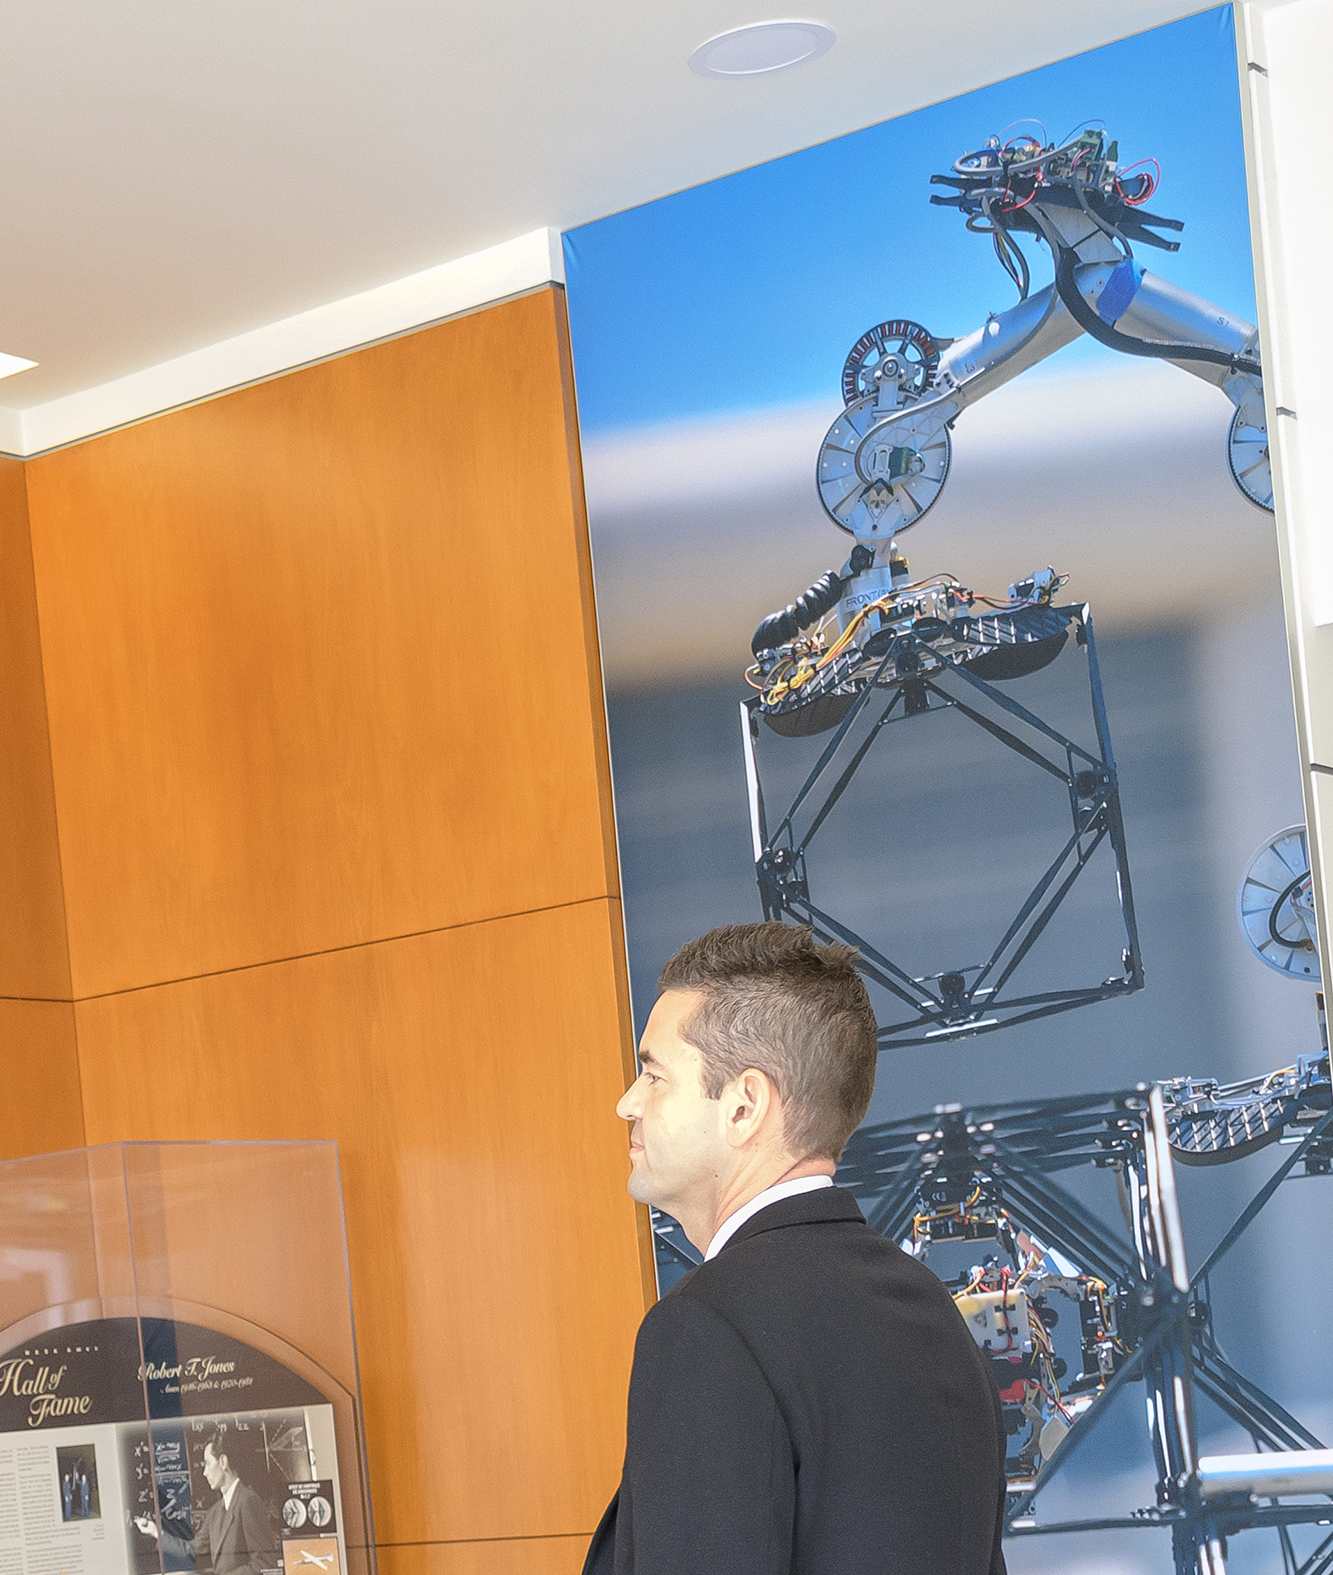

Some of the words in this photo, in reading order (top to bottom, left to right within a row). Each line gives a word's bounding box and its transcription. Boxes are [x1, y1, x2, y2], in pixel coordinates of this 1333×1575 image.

[47, 1364, 68, 1391] of
[137, 1360, 183, 1381] Robert
[198, 1355, 235, 1381] Jones
[27, 1393, 93, 1427] Fame
